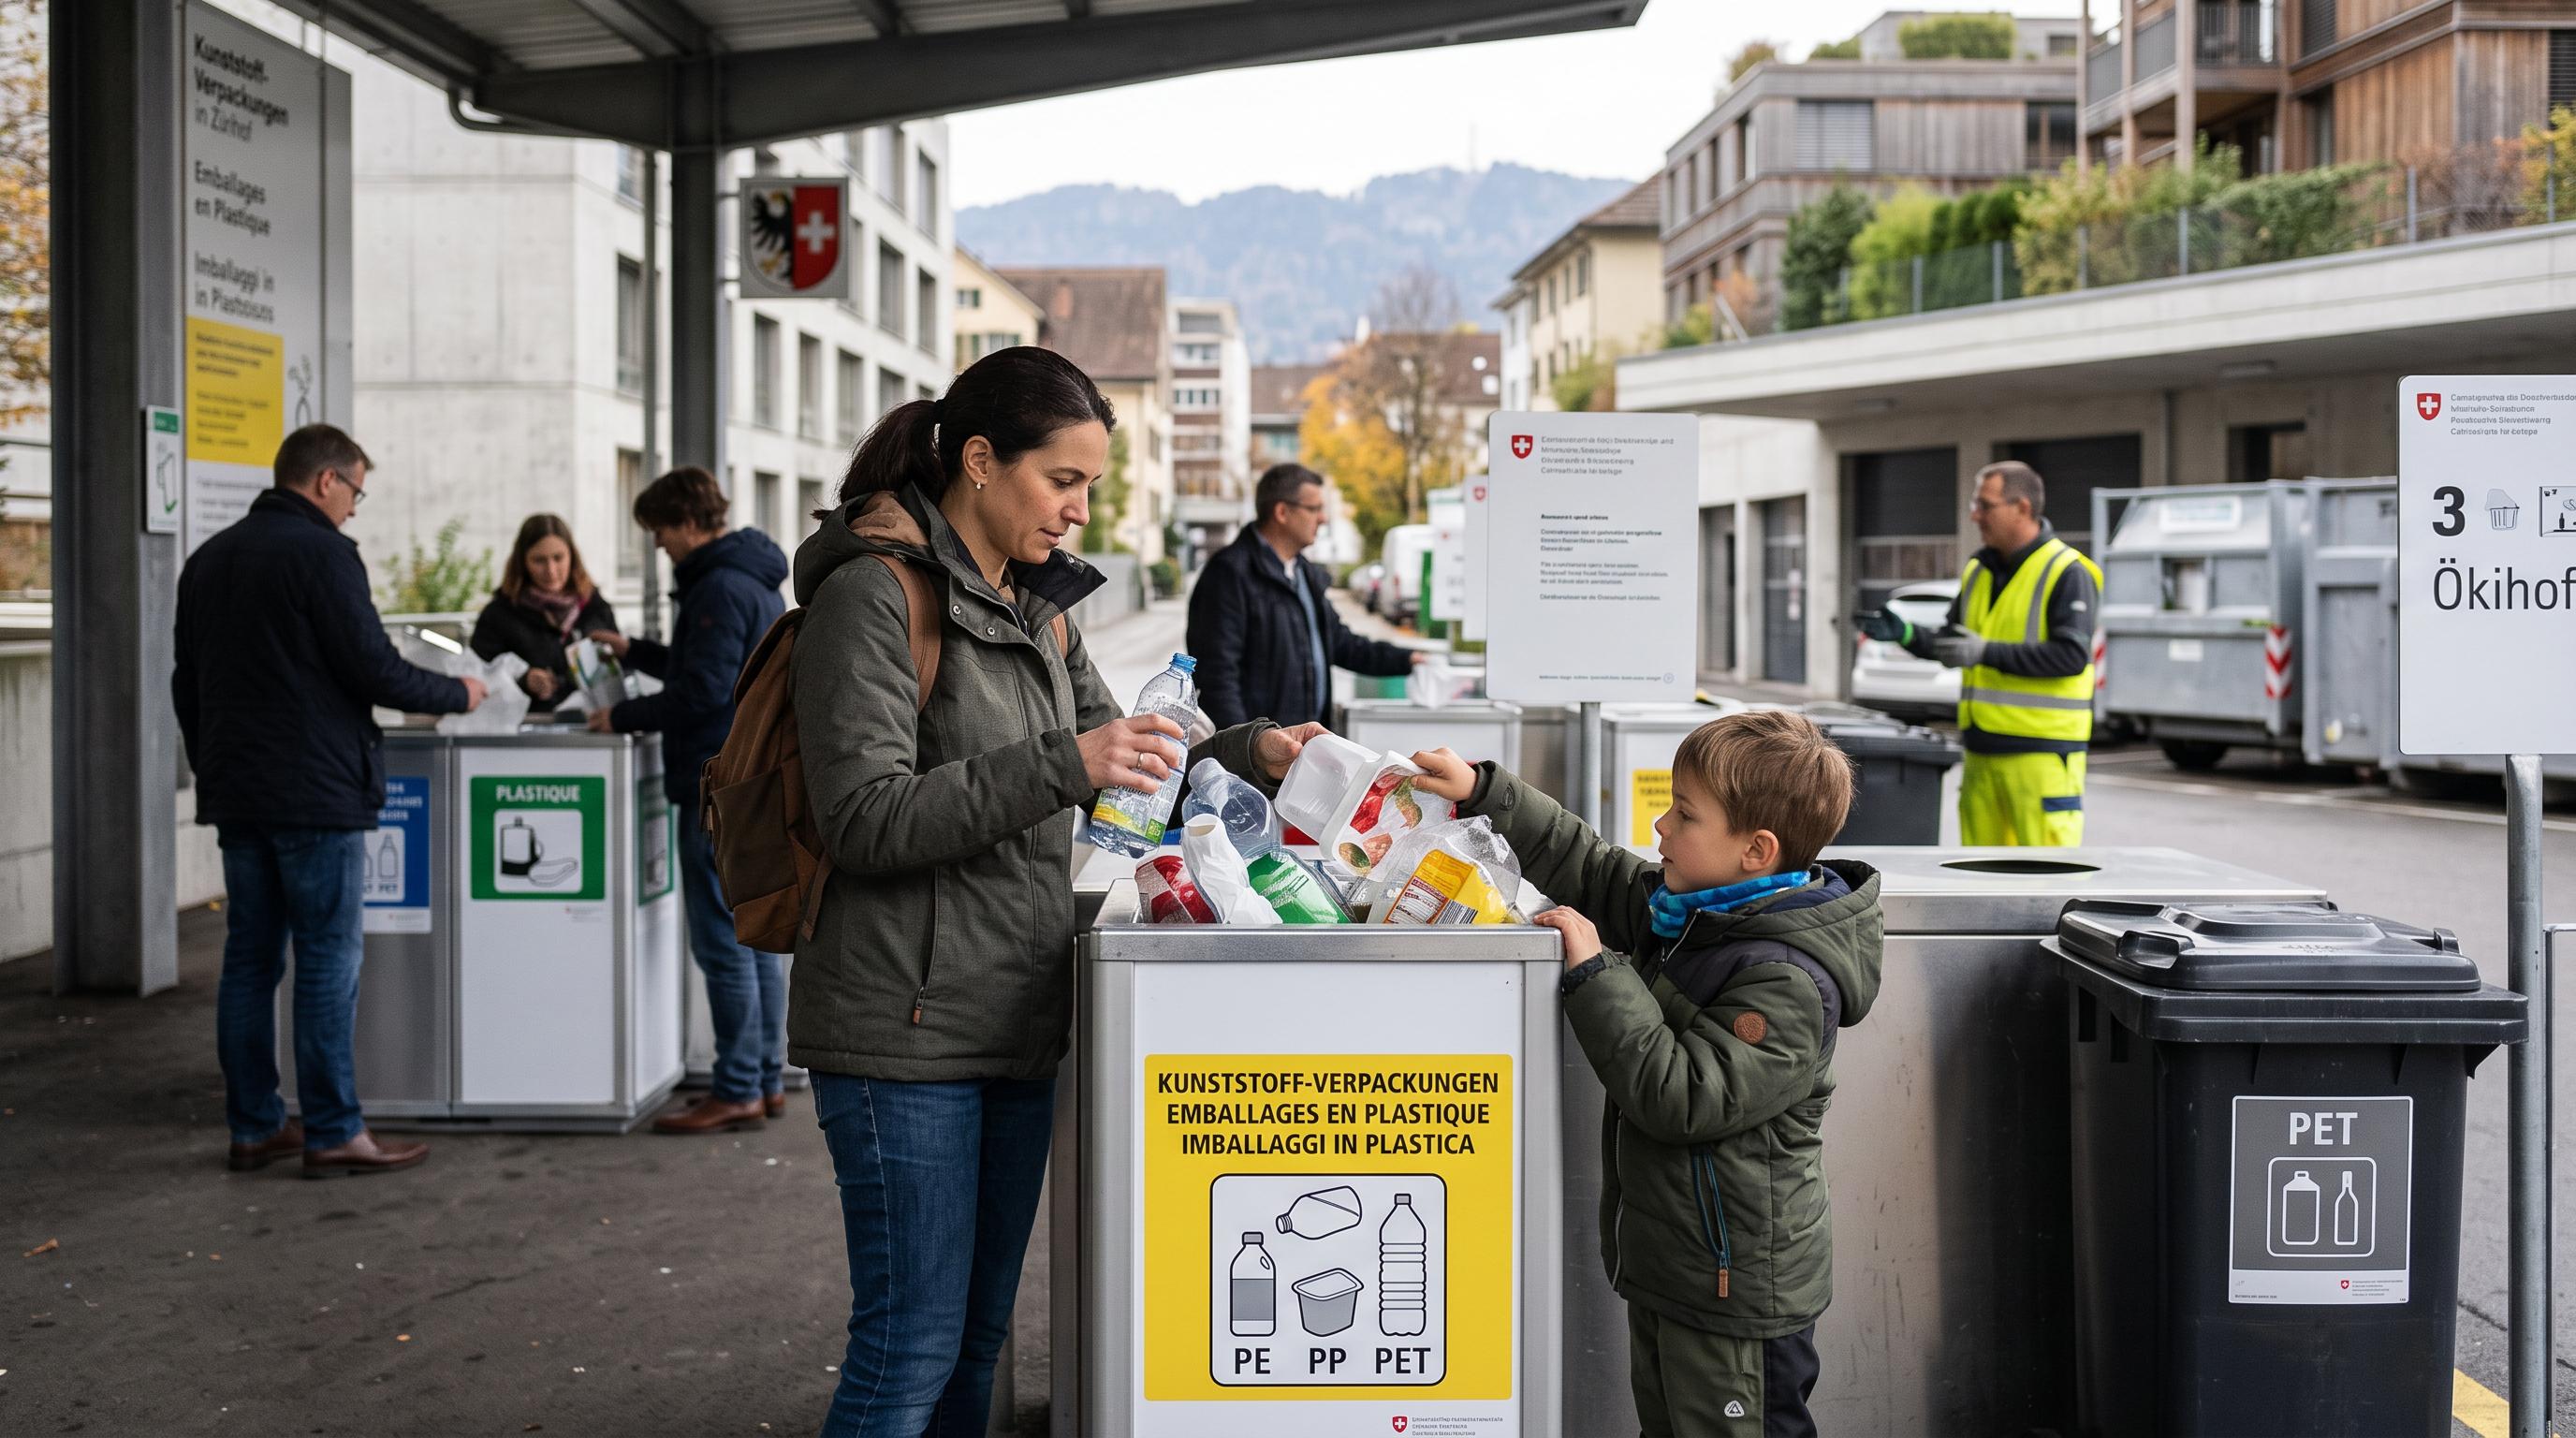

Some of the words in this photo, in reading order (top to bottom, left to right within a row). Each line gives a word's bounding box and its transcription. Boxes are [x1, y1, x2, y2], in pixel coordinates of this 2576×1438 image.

[194, 33, 269, 83] Kunststoff-
[194, 66, 289, 127] Verpackungen
[196, 159, 267, 205] Emballages
[196, 198, 211, 218] en
[214, 197, 271, 238] Plastique
[195, 250, 260, 296] Imballaggi
[2432, 486, 2466, 536] 3
[2434, 558, 2576, 610] Ökihof
[495, 784, 580, 803] PLASTIQUE
[1158, 1072, 1499, 1093] KUNSTSTOFF-VERPACKUNGEN
[1167, 1103, 1319, 1124] EMBALLAGES
[1327, 1103, 1356, 1124] EN
[1365, 1103, 1490, 1128] PLASTIQUE
[2289, 1111, 2359, 1146] PET
[1182, 1133, 1325, 1155] IMBALLAGGI
[1334, 1134, 1357, 1154] IN
[1366, 1133, 1475, 1154] PLASTICA
[1235, 1347, 1271, 1374] PE
[1309, 1347, 1347, 1374] PP
[1375, 1347, 1431, 1374] PET
